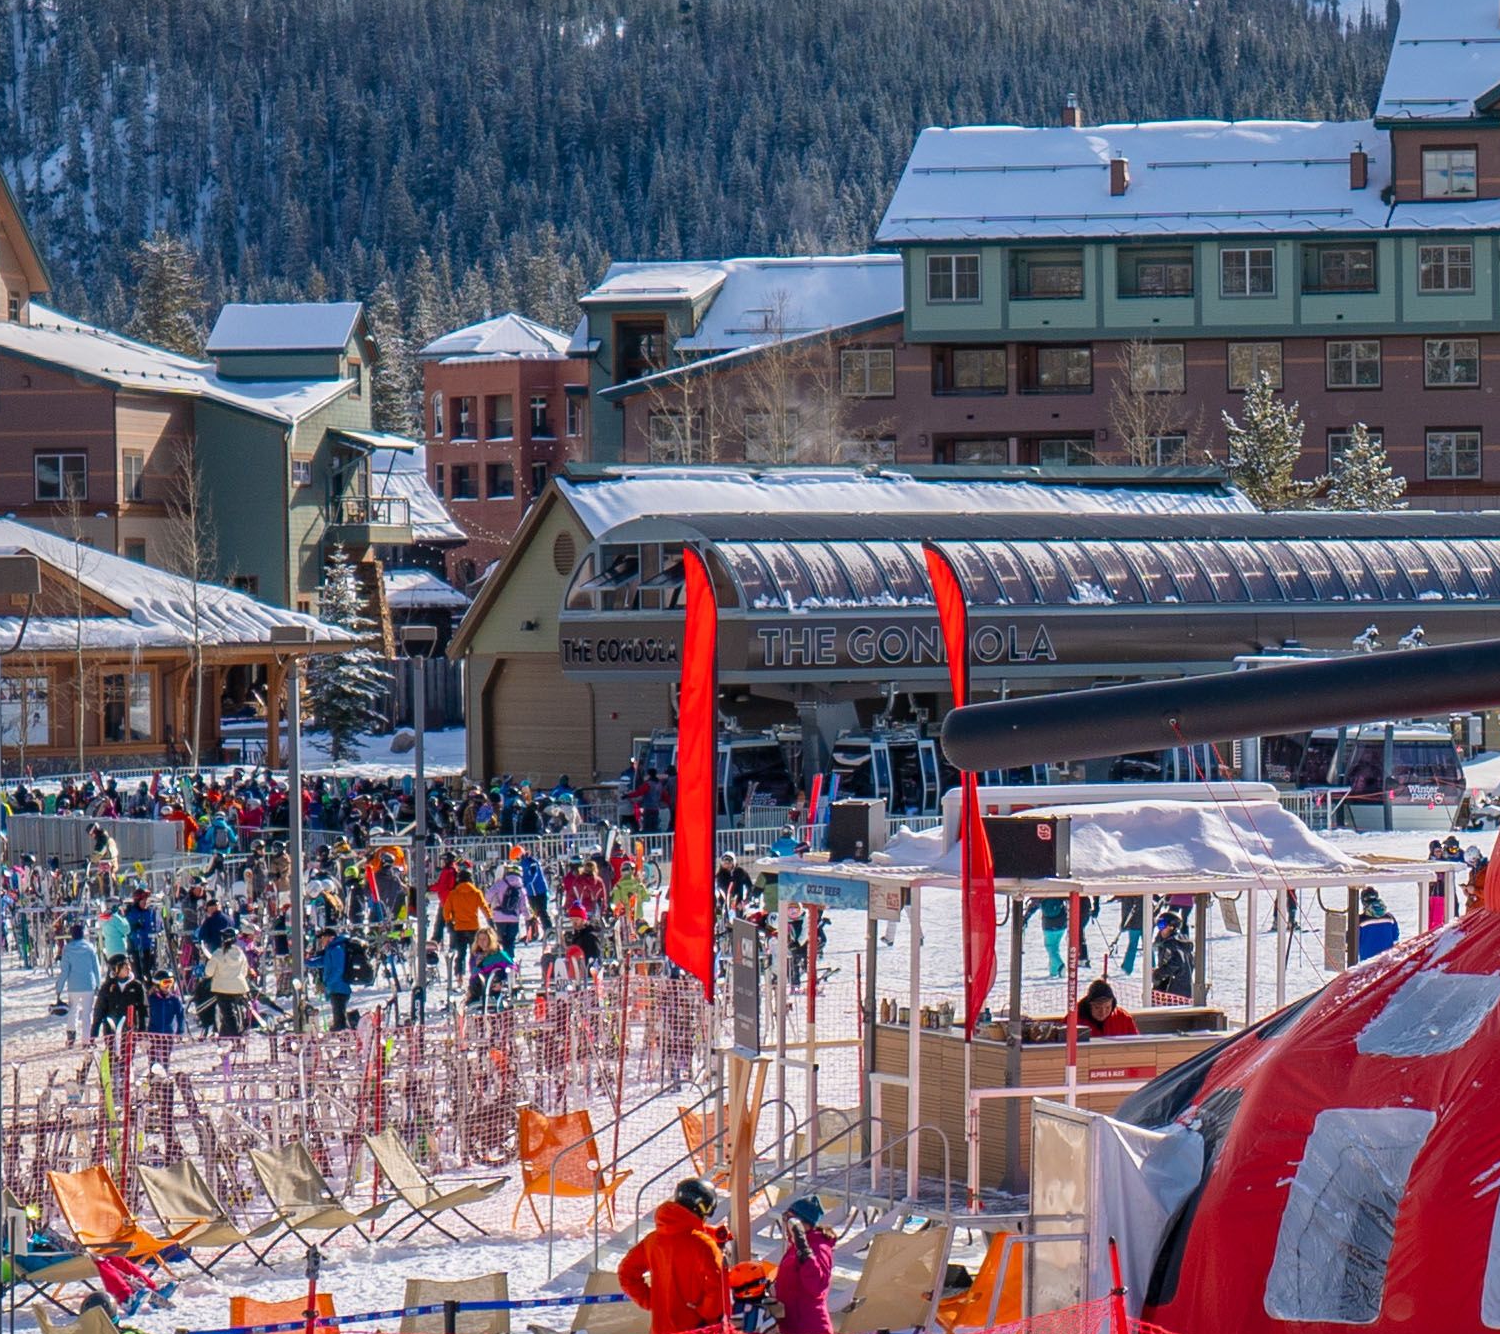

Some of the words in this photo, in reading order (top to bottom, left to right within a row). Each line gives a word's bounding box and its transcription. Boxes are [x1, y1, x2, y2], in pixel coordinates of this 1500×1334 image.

[562, 637, 593, 665] THE
[596, 637, 678, 665] GONDOLA
[758, 625, 837, 665] THE
[845, 624, 1057, 664] GONOLA
[1408, 785, 1440, 795] Winter
[1410, 792, 1433, 803] park
[807, 884, 823, 895] COLD
[824, 885, 841, 897] BEER
[1068, 980, 1076, 1012] ALPINE
